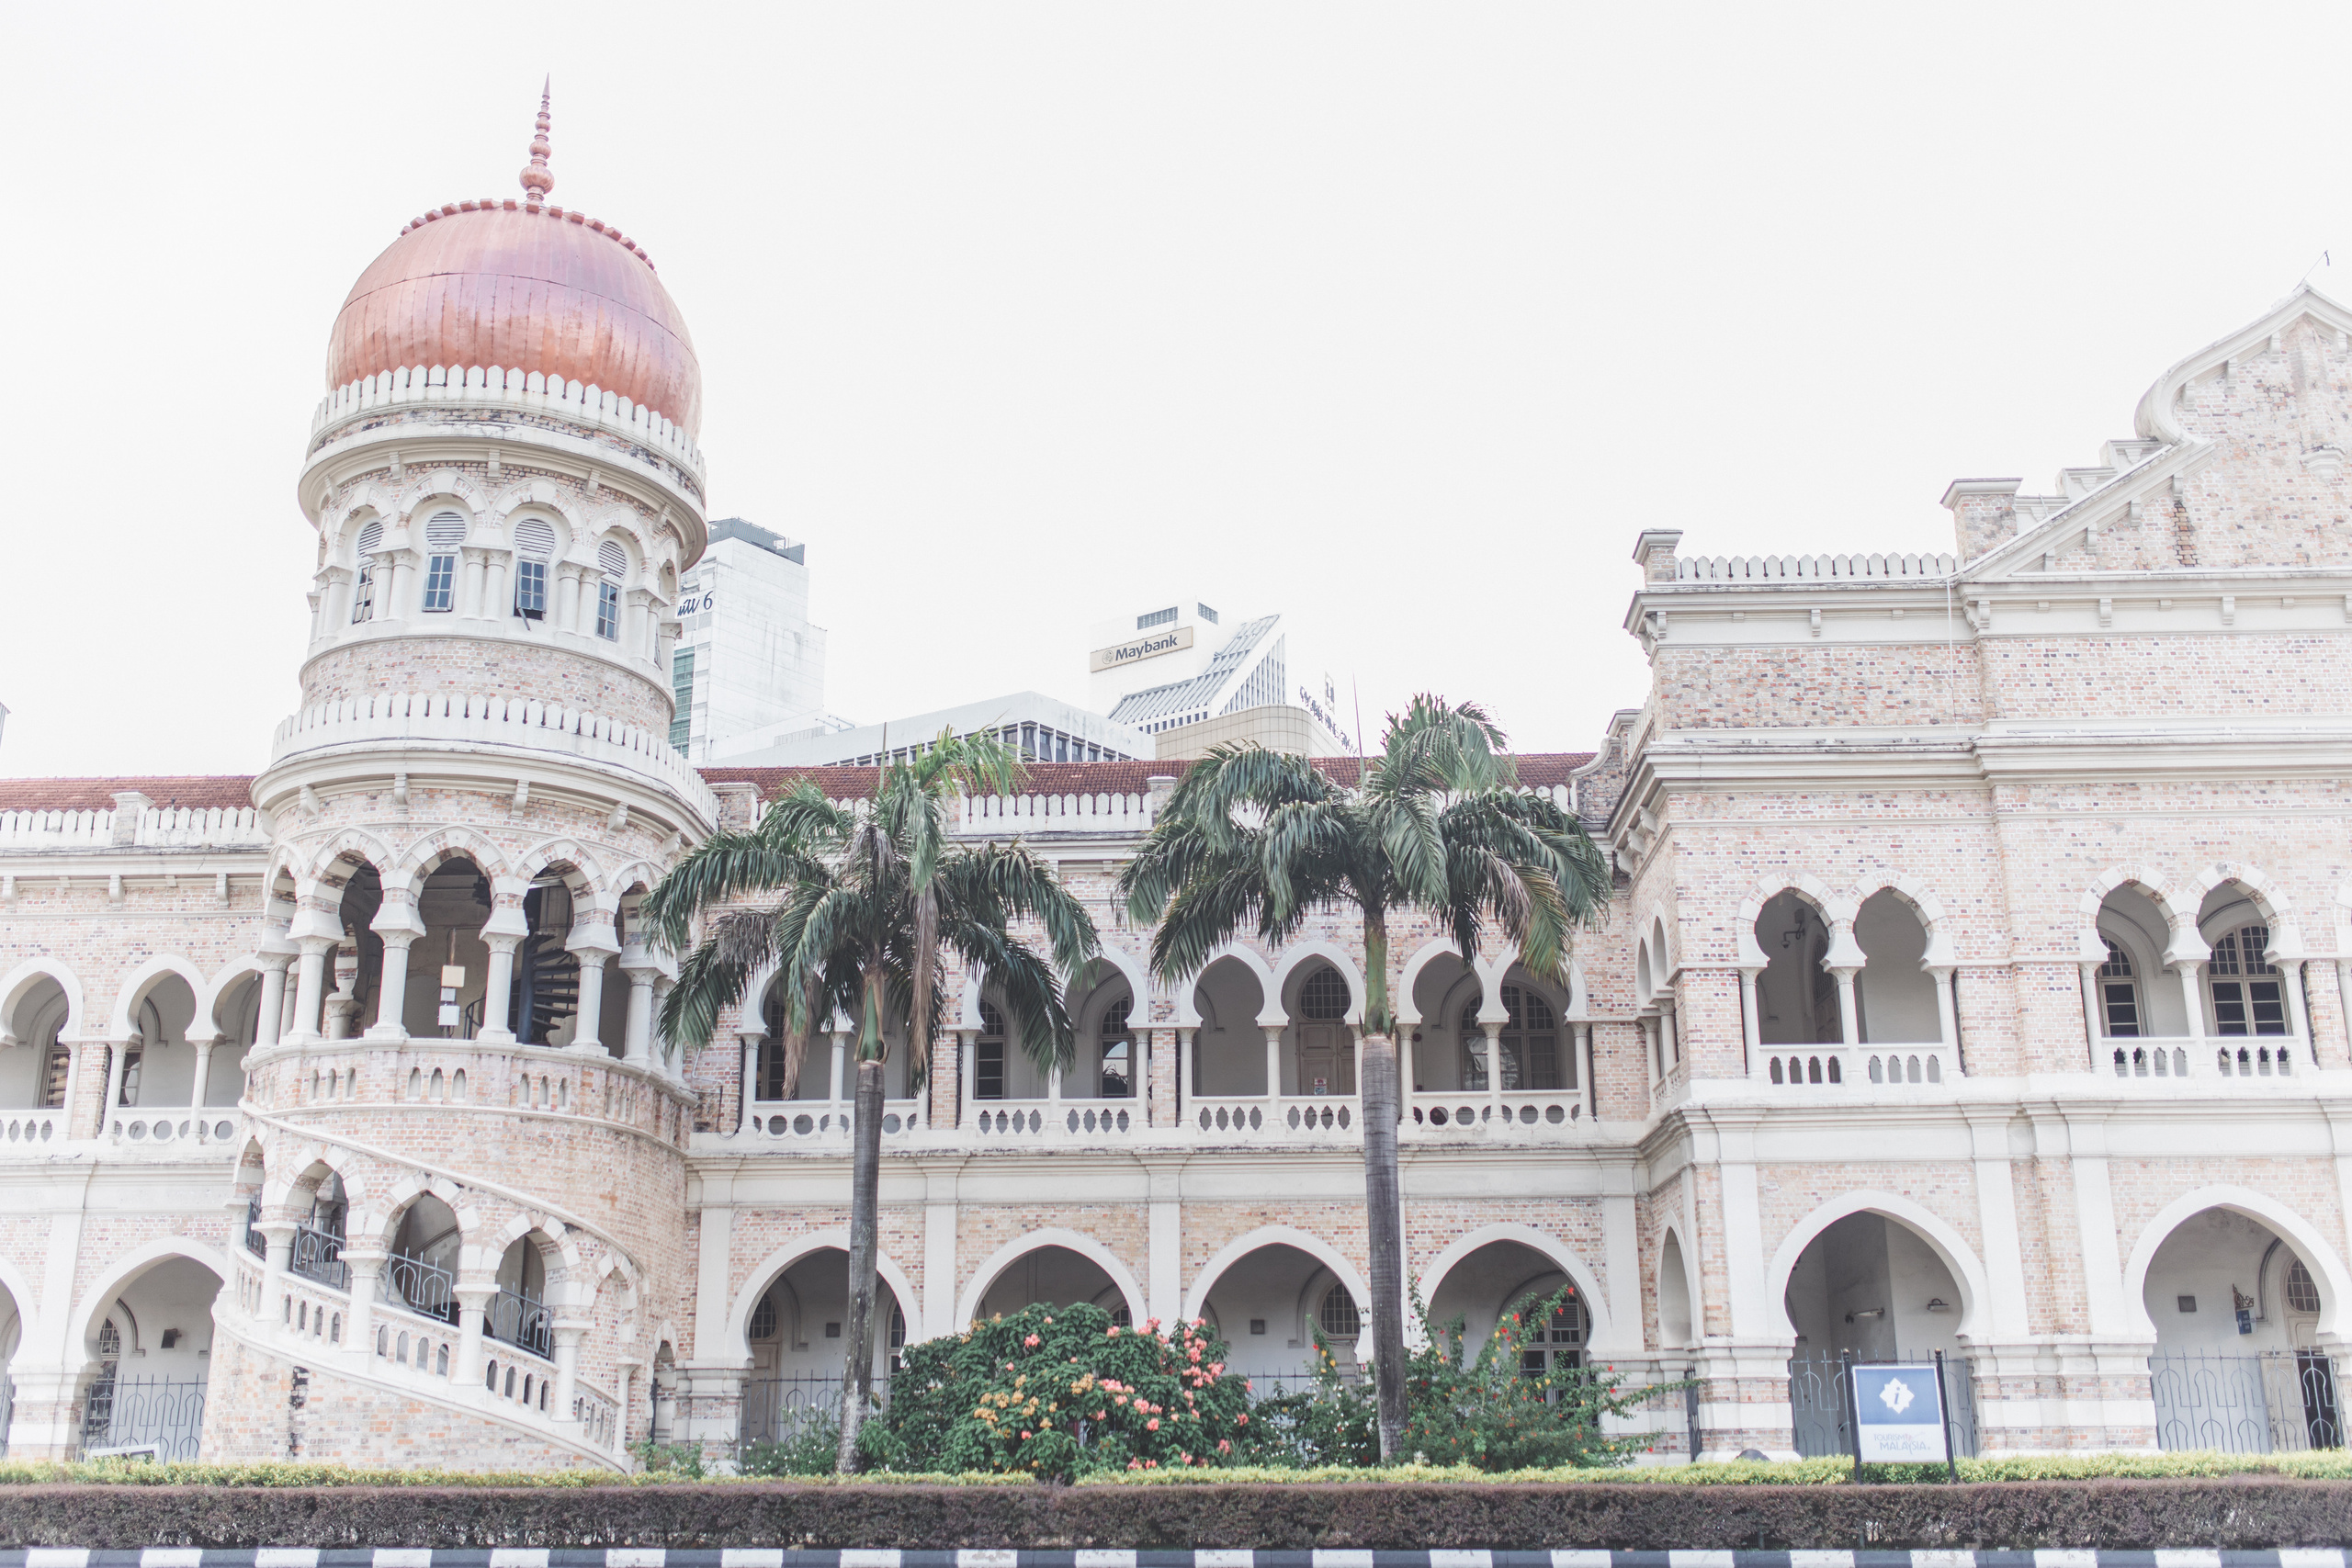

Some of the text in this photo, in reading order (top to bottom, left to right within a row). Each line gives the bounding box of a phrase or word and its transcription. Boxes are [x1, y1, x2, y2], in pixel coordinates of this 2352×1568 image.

[703, 590, 714, 610] 6
[1115, 634, 1178, 661] Maybank
[1894, 1386, 1900, 1404] i
[1880, 1441, 1927, 1455] MALAYSIA
